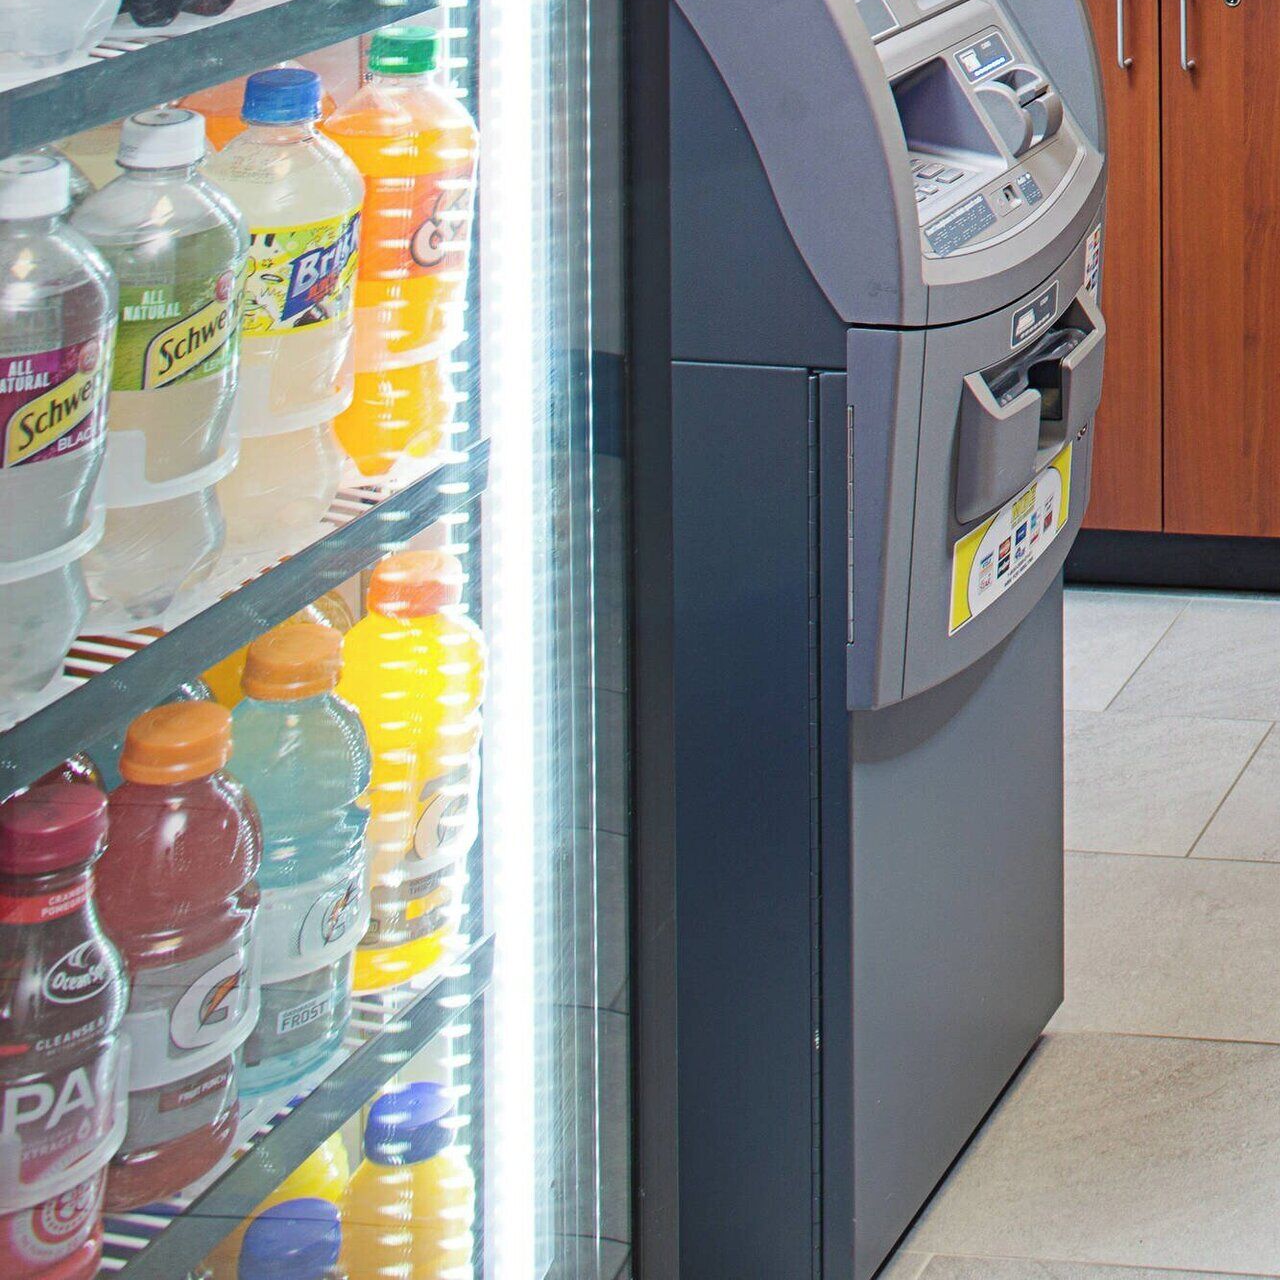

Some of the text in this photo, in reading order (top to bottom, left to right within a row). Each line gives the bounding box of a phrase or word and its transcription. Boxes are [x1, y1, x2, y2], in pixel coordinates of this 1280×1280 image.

[140, 288, 166, 305] ALL
[122, 300, 182, 322] NATURAL
[158, 306, 229, 377] Schwe
[8, 358, 34, 374] ALL
[0, 371, 51, 394] ATURAL
[18, 378, 93, 452] Schwe
[56, 429, 96, 453] BLAC
[281, 1001, 328, 1032] FROST
